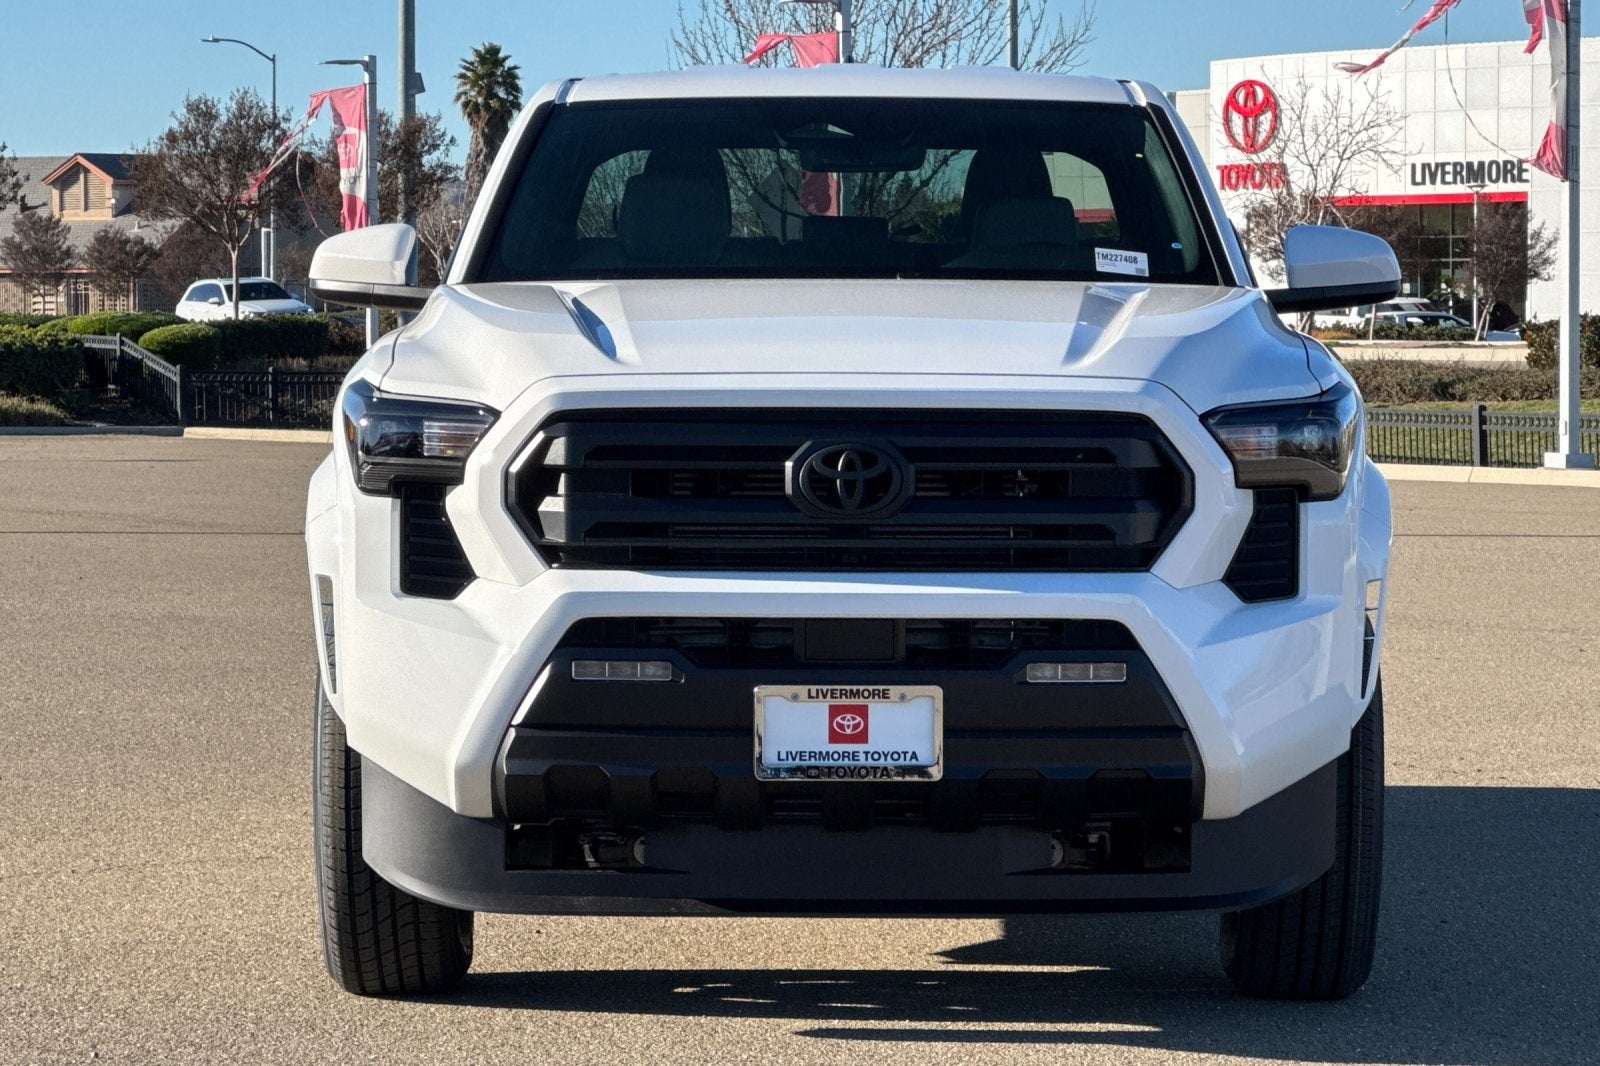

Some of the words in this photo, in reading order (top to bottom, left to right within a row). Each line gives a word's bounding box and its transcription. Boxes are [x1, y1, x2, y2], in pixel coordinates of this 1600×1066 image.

[1216, 163, 1286, 191] TOYOTA
[1411, 160, 1529, 186] LIVERMORE
[1097, 252, 1139, 265] TM227408
[807, 688, 891, 700] LIVERMORE
[777, 751, 860, 762] LIVERMORE
[864, 751, 919, 762] TOYOTA
[826, 766, 891, 779] TOYOTA
